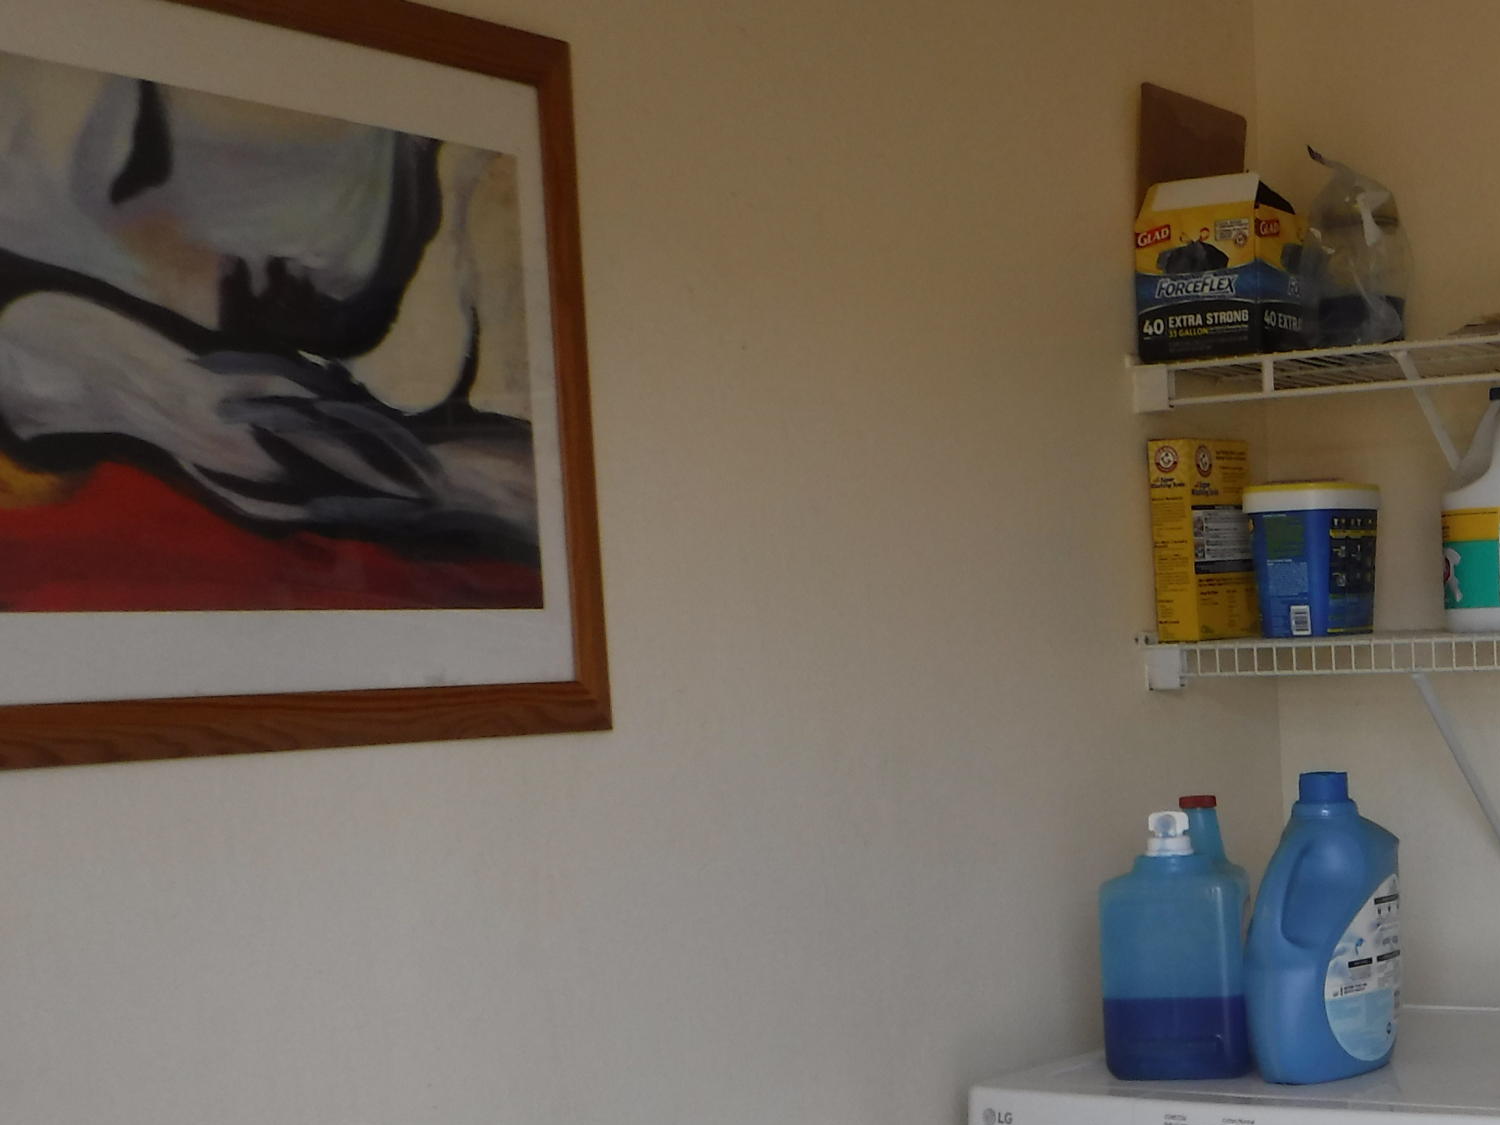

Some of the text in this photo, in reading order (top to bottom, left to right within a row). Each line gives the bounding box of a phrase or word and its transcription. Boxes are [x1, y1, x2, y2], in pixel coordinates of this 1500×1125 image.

[1138, 226, 1170, 246] GLAD
[1143, 309, 1249, 336] 40 EXTRA STRONG
[998, 1112, 1013, 1125] LG
